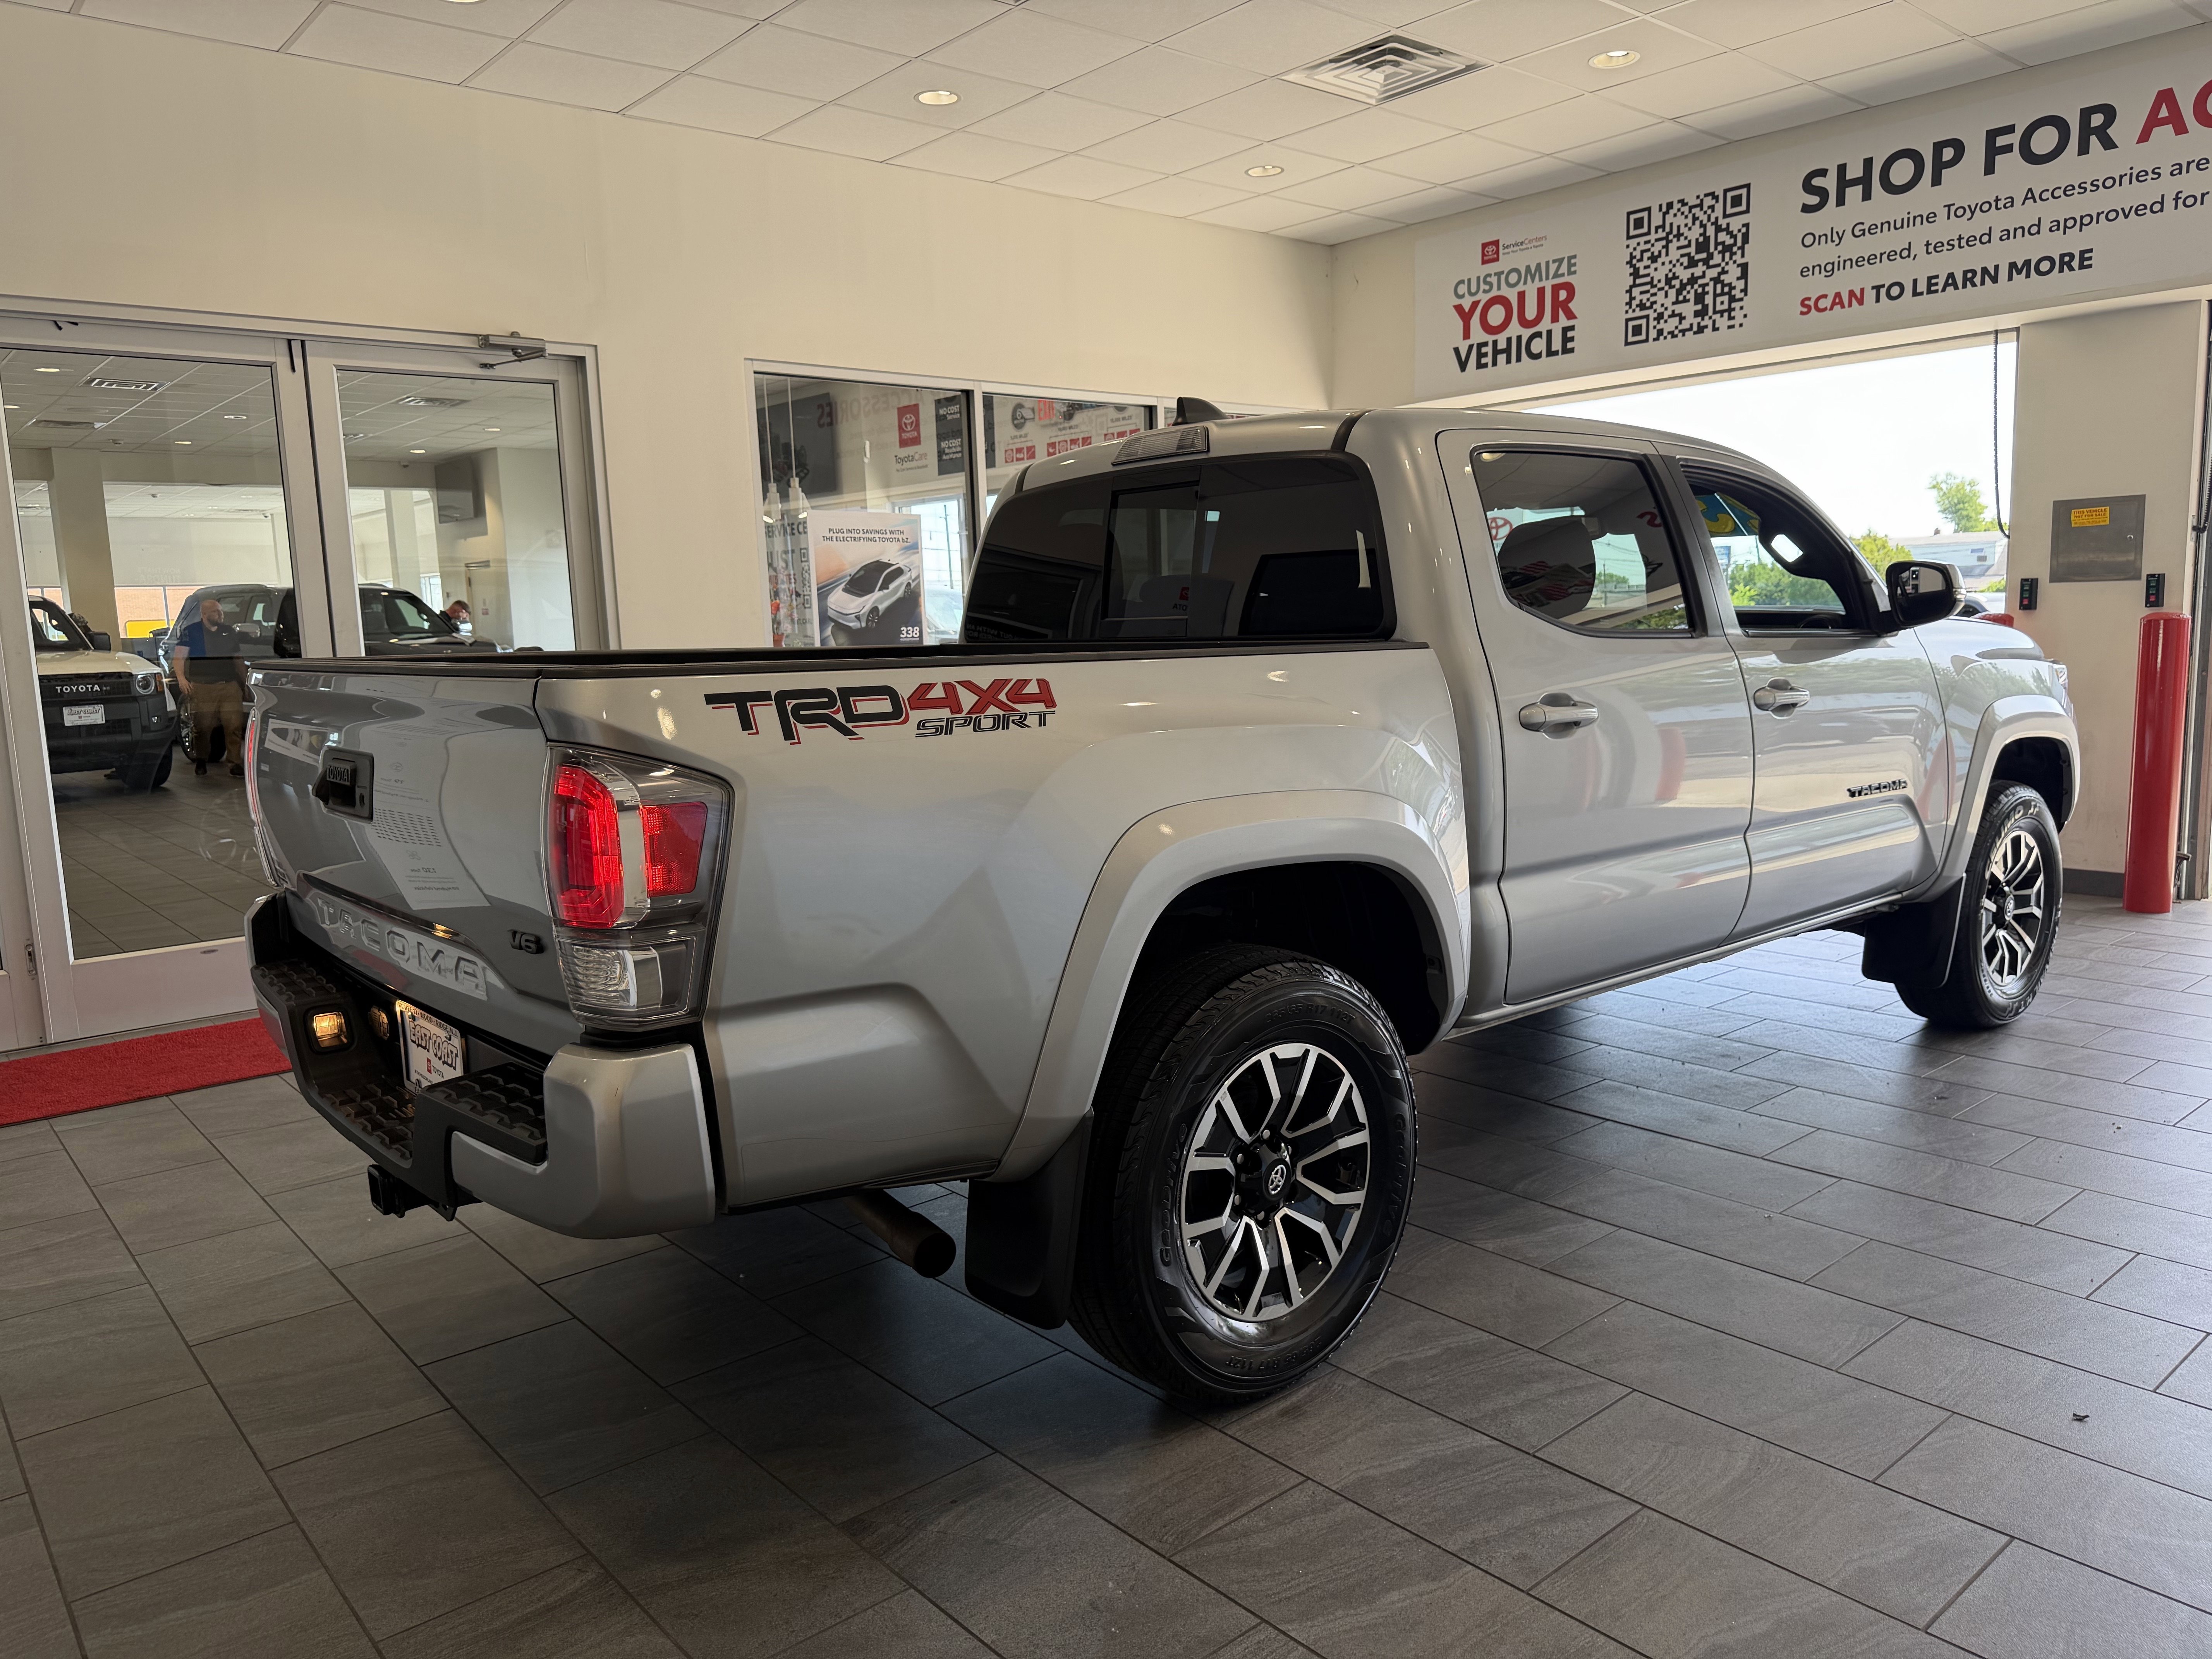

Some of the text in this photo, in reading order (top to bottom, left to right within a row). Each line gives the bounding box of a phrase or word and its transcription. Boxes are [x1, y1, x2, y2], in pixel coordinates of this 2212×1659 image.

[1800, 138, 1965, 215] SHOP
[1983, 103, 2119, 176] FOR
[1801, 157, 2209, 248] Only Genuine Toyota Accessories are
[1502, 235, 1547, 250] ServiceCenters
[1800, 189, 2209, 278] engineered, tested and approved for
[1453, 254, 1577, 299] CUSTOMIZE
[1799, 248, 2093, 316] SCAN TO LEARN MORE
[1453, 282, 1578, 341] YOUR
[1453, 325, 1575, 373] VEHICLE
[939, 404, 960, 415] NO COST
[950, 438, 962, 447] COST
[895, 452, 928, 466] ToyotaCare
[765, 522, 795, 538] ERVICE
[900, 626, 920, 638] 338
[55, 684, 100, 693] TOYOTA
[704, 678, 1057, 745] TRD 4X4
[915, 711, 1056, 738] SPORT
[328, 764, 349, 783] TOYOTA
[1846, 778, 1908, 798] TACOMA
[318, 896, 488, 1001] TACOMA
[507, 929, 544, 955] V6
[409, 1020, 459, 1071] EAST COAST
[432, 1065, 445, 1079] TOYOTA
